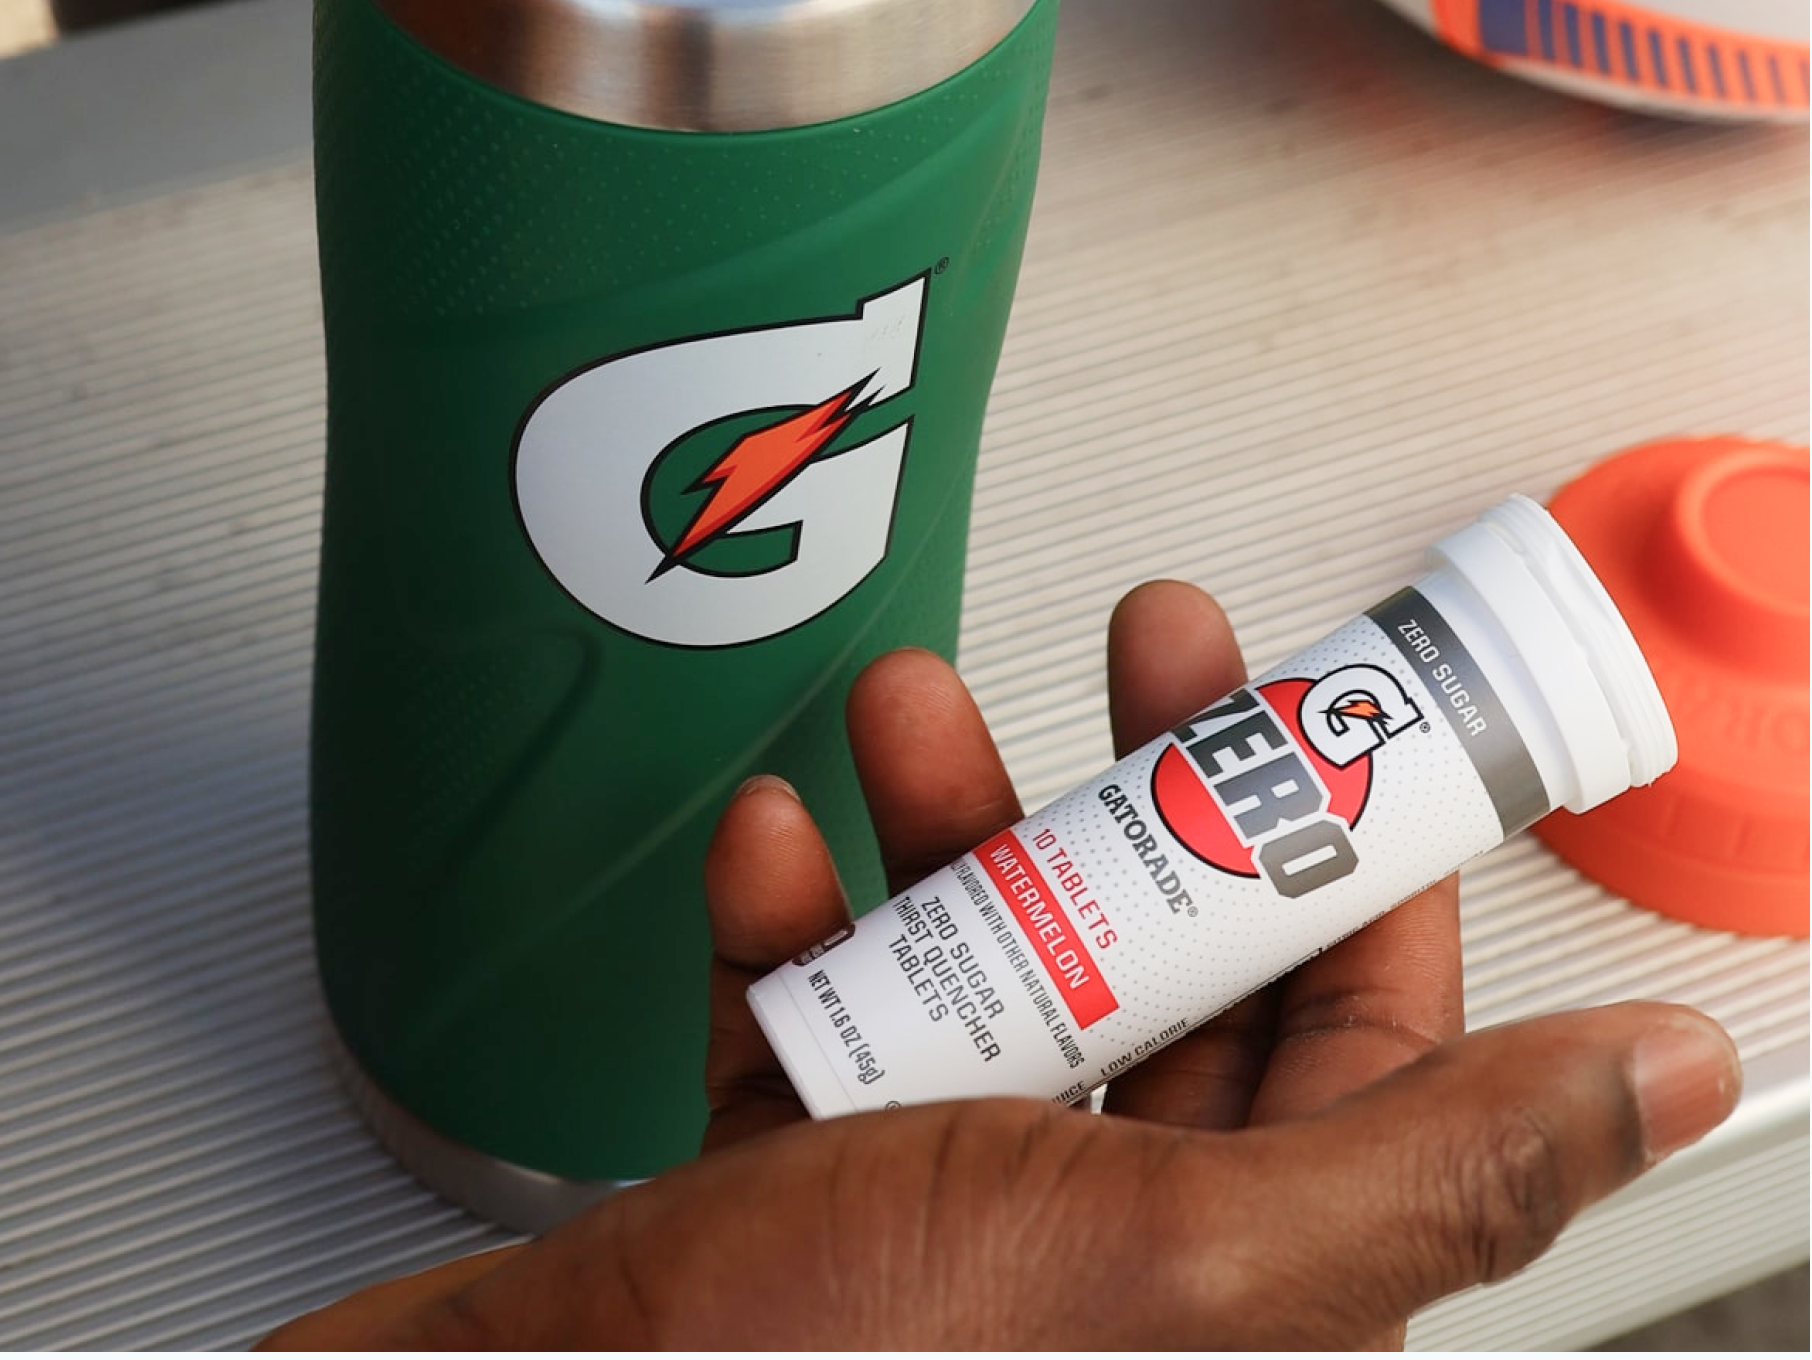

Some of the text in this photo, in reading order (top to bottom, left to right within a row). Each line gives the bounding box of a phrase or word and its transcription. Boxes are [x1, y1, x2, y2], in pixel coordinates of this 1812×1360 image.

[1398, 619, 1487, 737] ZERO SUGAR
[1169, 687, 1359, 899] ZERO
[990, 844, 1089, 990] WATERMELON
[1033, 828, 1118, 949] 10 TABLETS
[888, 934, 949, 1022] TABLETS
[892, 896, 1002, 1063] THIRST QUENCHER
[920, 896, 1005, 1020] ZERO SUGAR
[979, 901, 1008, 935] WITH
[996, 930, 1030, 974] OTHER
[1018, 968, 1060, 1028] NATURAL
[1049, 1021, 1086, 1070] FLAVORS
[808, 968, 886, 1085] NET WT 1.6 OZ (45g)
[1100, 1016, 1190, 1077] LOW CALORIE
